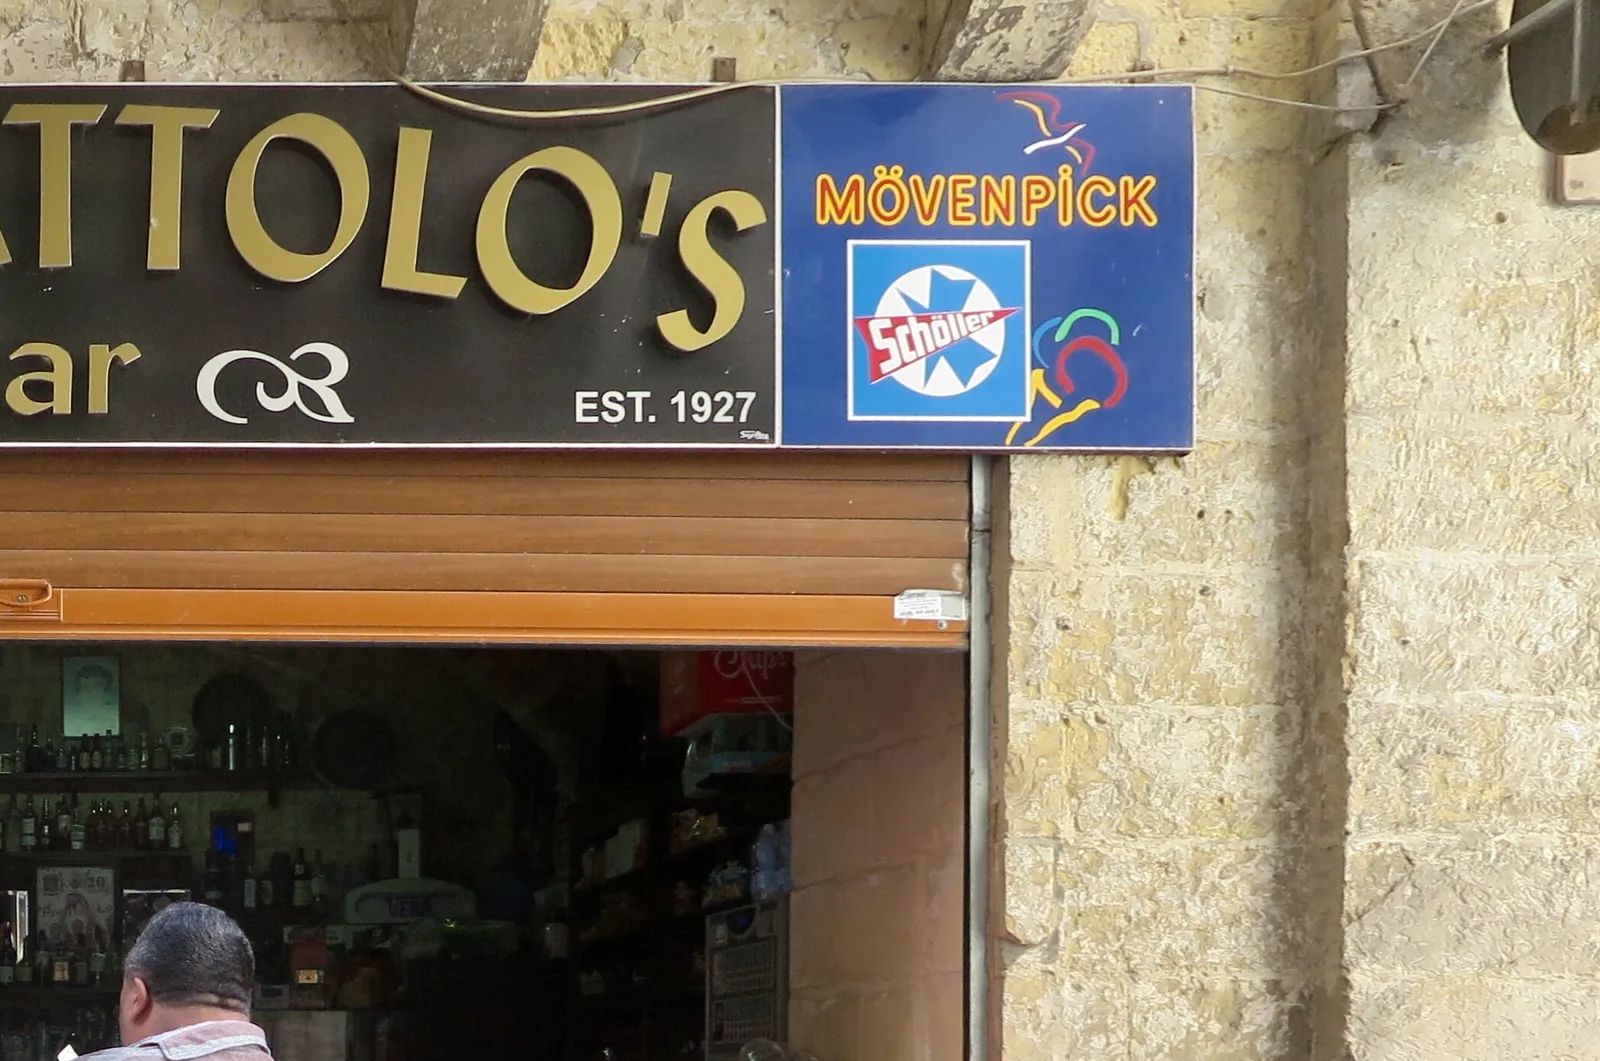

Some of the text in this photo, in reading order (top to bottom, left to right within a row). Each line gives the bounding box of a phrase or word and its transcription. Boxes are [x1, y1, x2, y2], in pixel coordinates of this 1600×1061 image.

[867, 310, 995, 375] Schöller
[574, 390, 757, 424] EST. 1927
